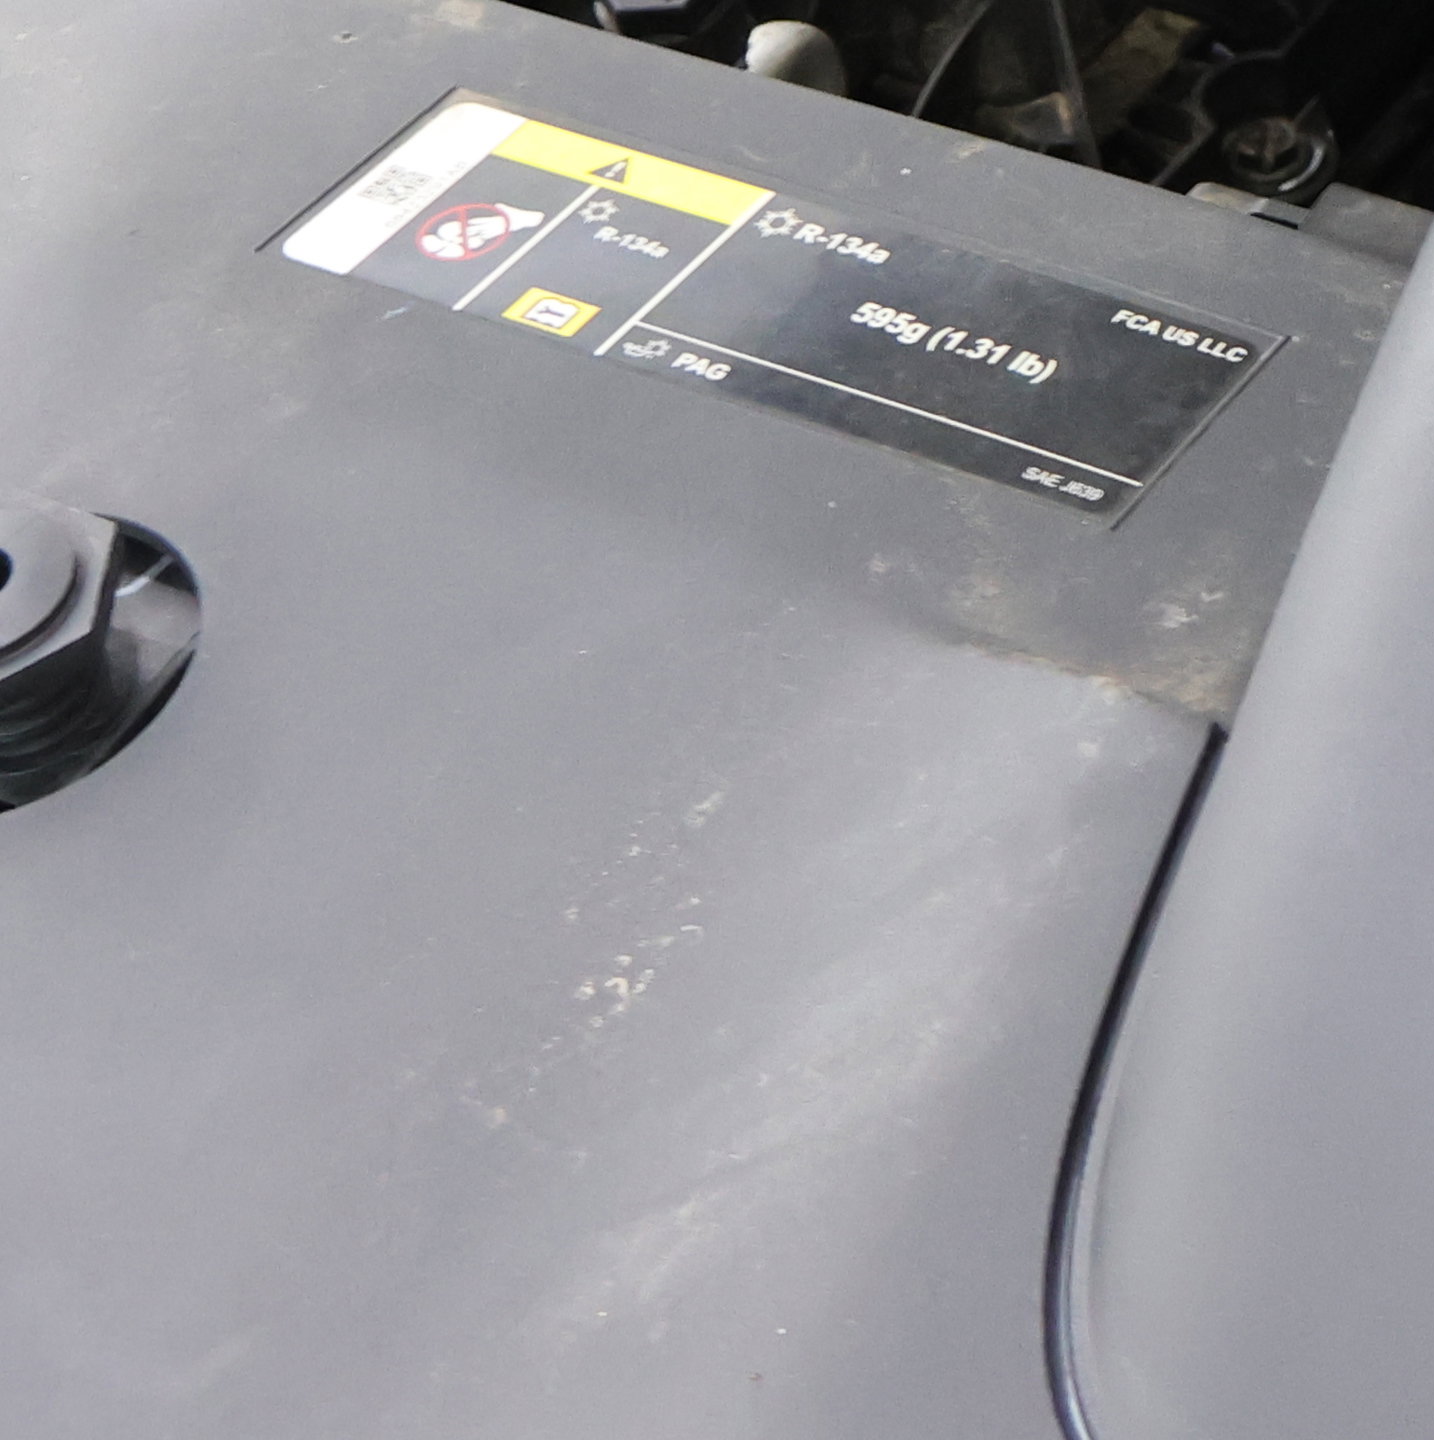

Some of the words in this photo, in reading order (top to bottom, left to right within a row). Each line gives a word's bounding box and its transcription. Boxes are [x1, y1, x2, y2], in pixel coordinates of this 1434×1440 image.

[793, 222, 891, 264] R-134a
[849, 301, 932, 345] 595g
[925, 325, 1012, 366] (1.31
[1006, 350, 1060, 385] lb)
[1110, 308, 1163, 337] FCA
[1162, 324, 1200, 347] US
[1197, 335, 1249, 364] LLC
[671, 351, 732, 382] PAG
[1021, 466, 1066, 489] SAE
